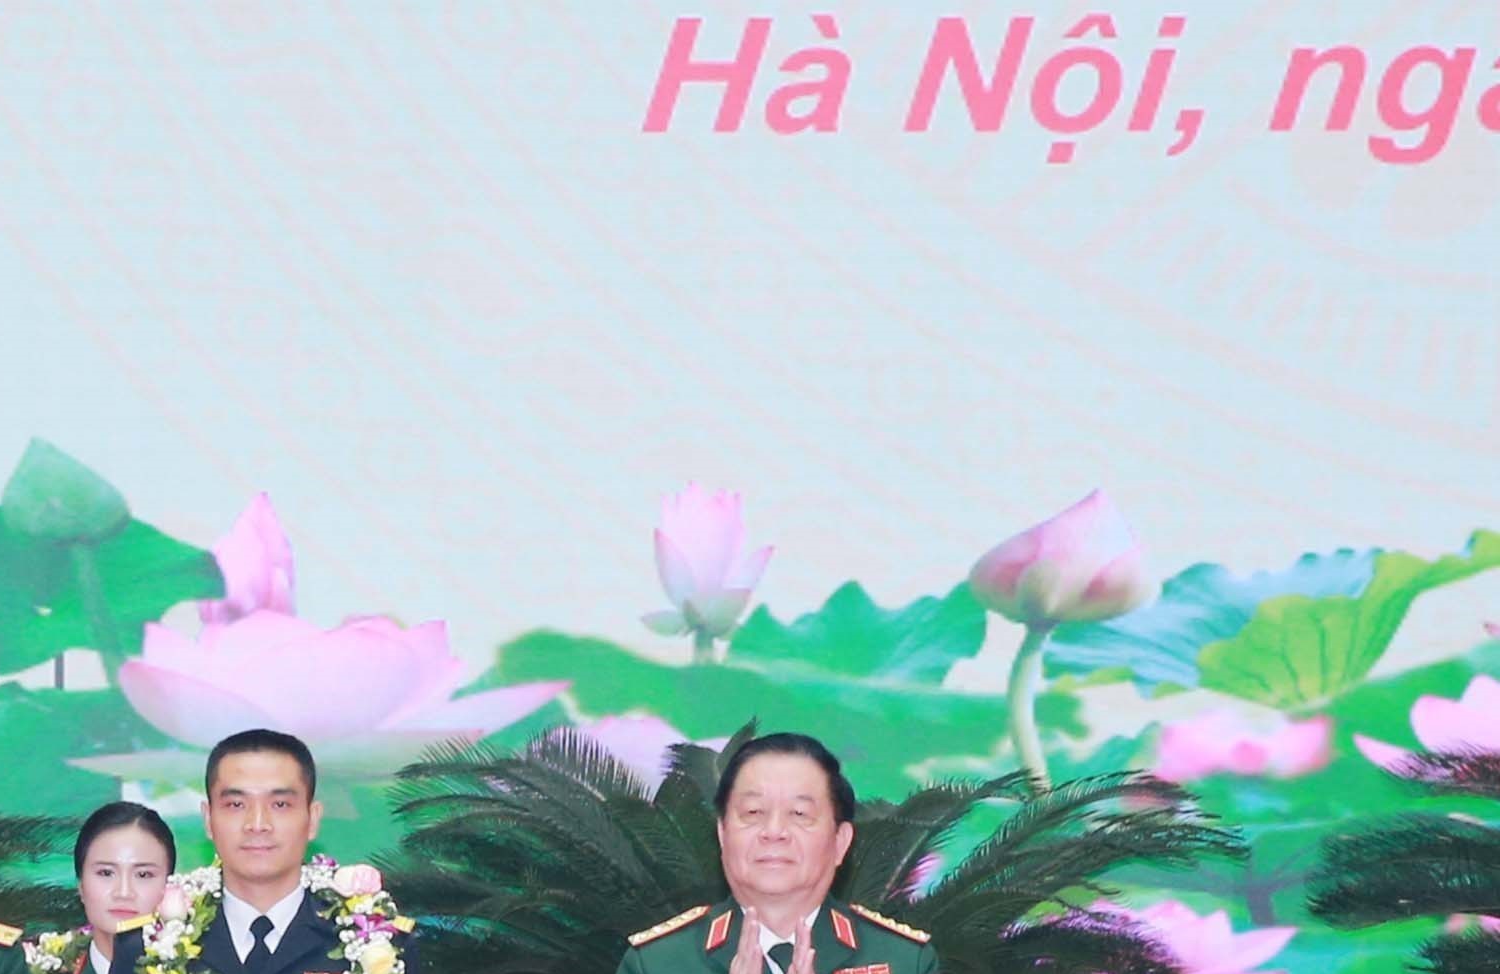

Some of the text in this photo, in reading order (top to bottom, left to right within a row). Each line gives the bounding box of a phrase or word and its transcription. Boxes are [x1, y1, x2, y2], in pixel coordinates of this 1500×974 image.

[643, 13, 1500, 165] Hà Nội, ng
